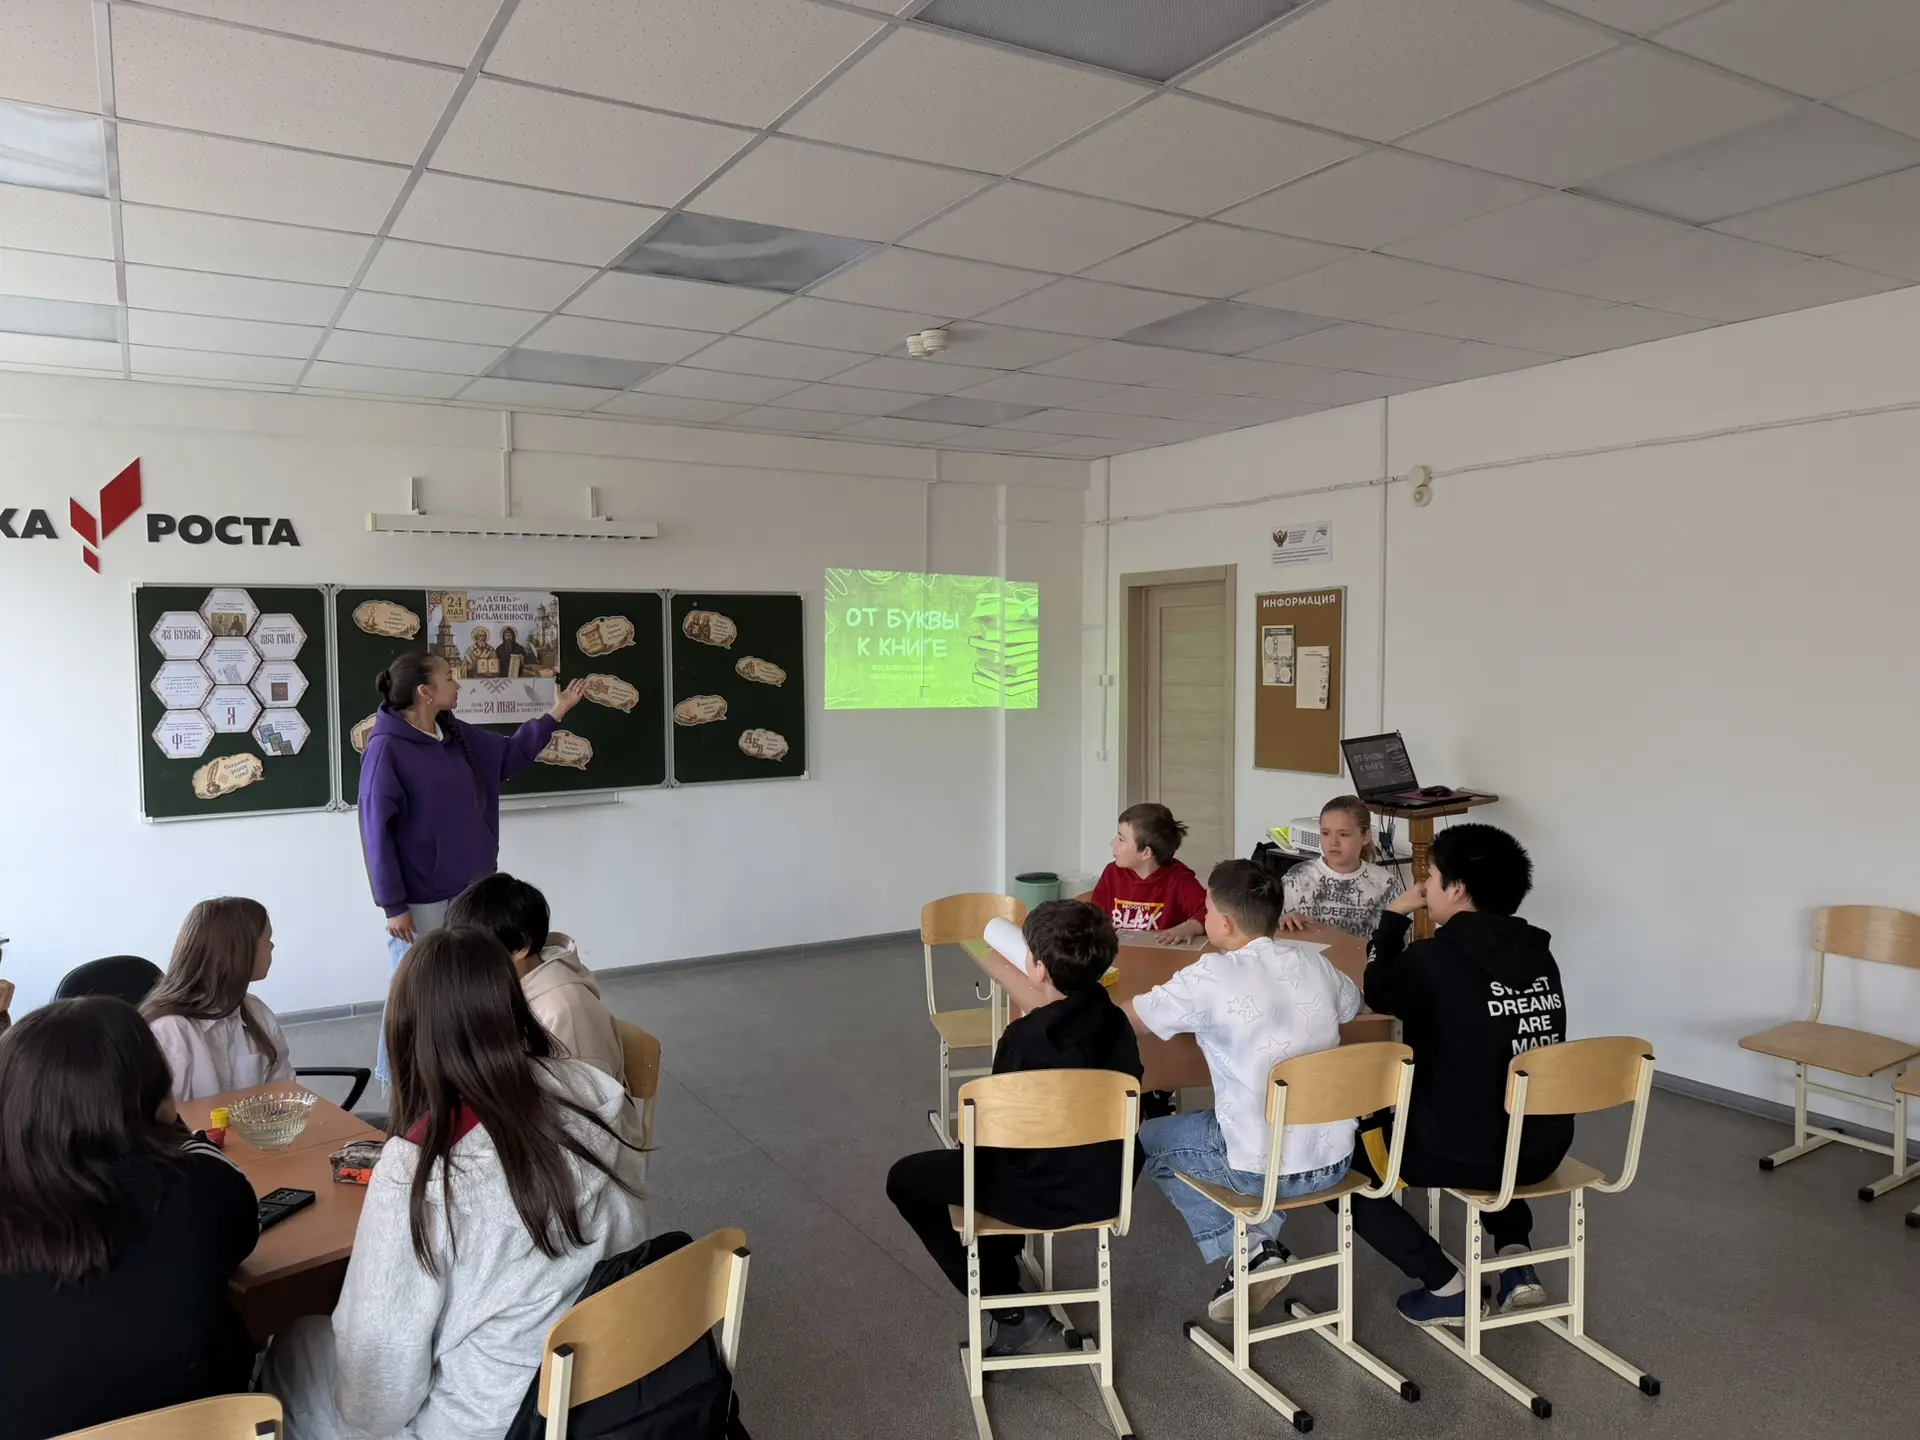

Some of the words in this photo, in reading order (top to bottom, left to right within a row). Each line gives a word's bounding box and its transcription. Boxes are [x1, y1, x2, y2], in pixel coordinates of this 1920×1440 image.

[146, 513, 300, 546] РОСТА
[447, 596, 462, 608] 24
[1263, 594, 1336, 608] ИНФОРМАЦИЯ
[446, 608, 464, 616] МАЯ
[846, 607, 878, 627] ОТ
[887, 608, 959, 632] БУКВЫ
[857, 637, 870, 657] К
[879, 637, 948, 658] КНИГЕ
[1487, 993, 1562, 1017] DREAMS
[1517, 1015, 1552, 1035] ARE
